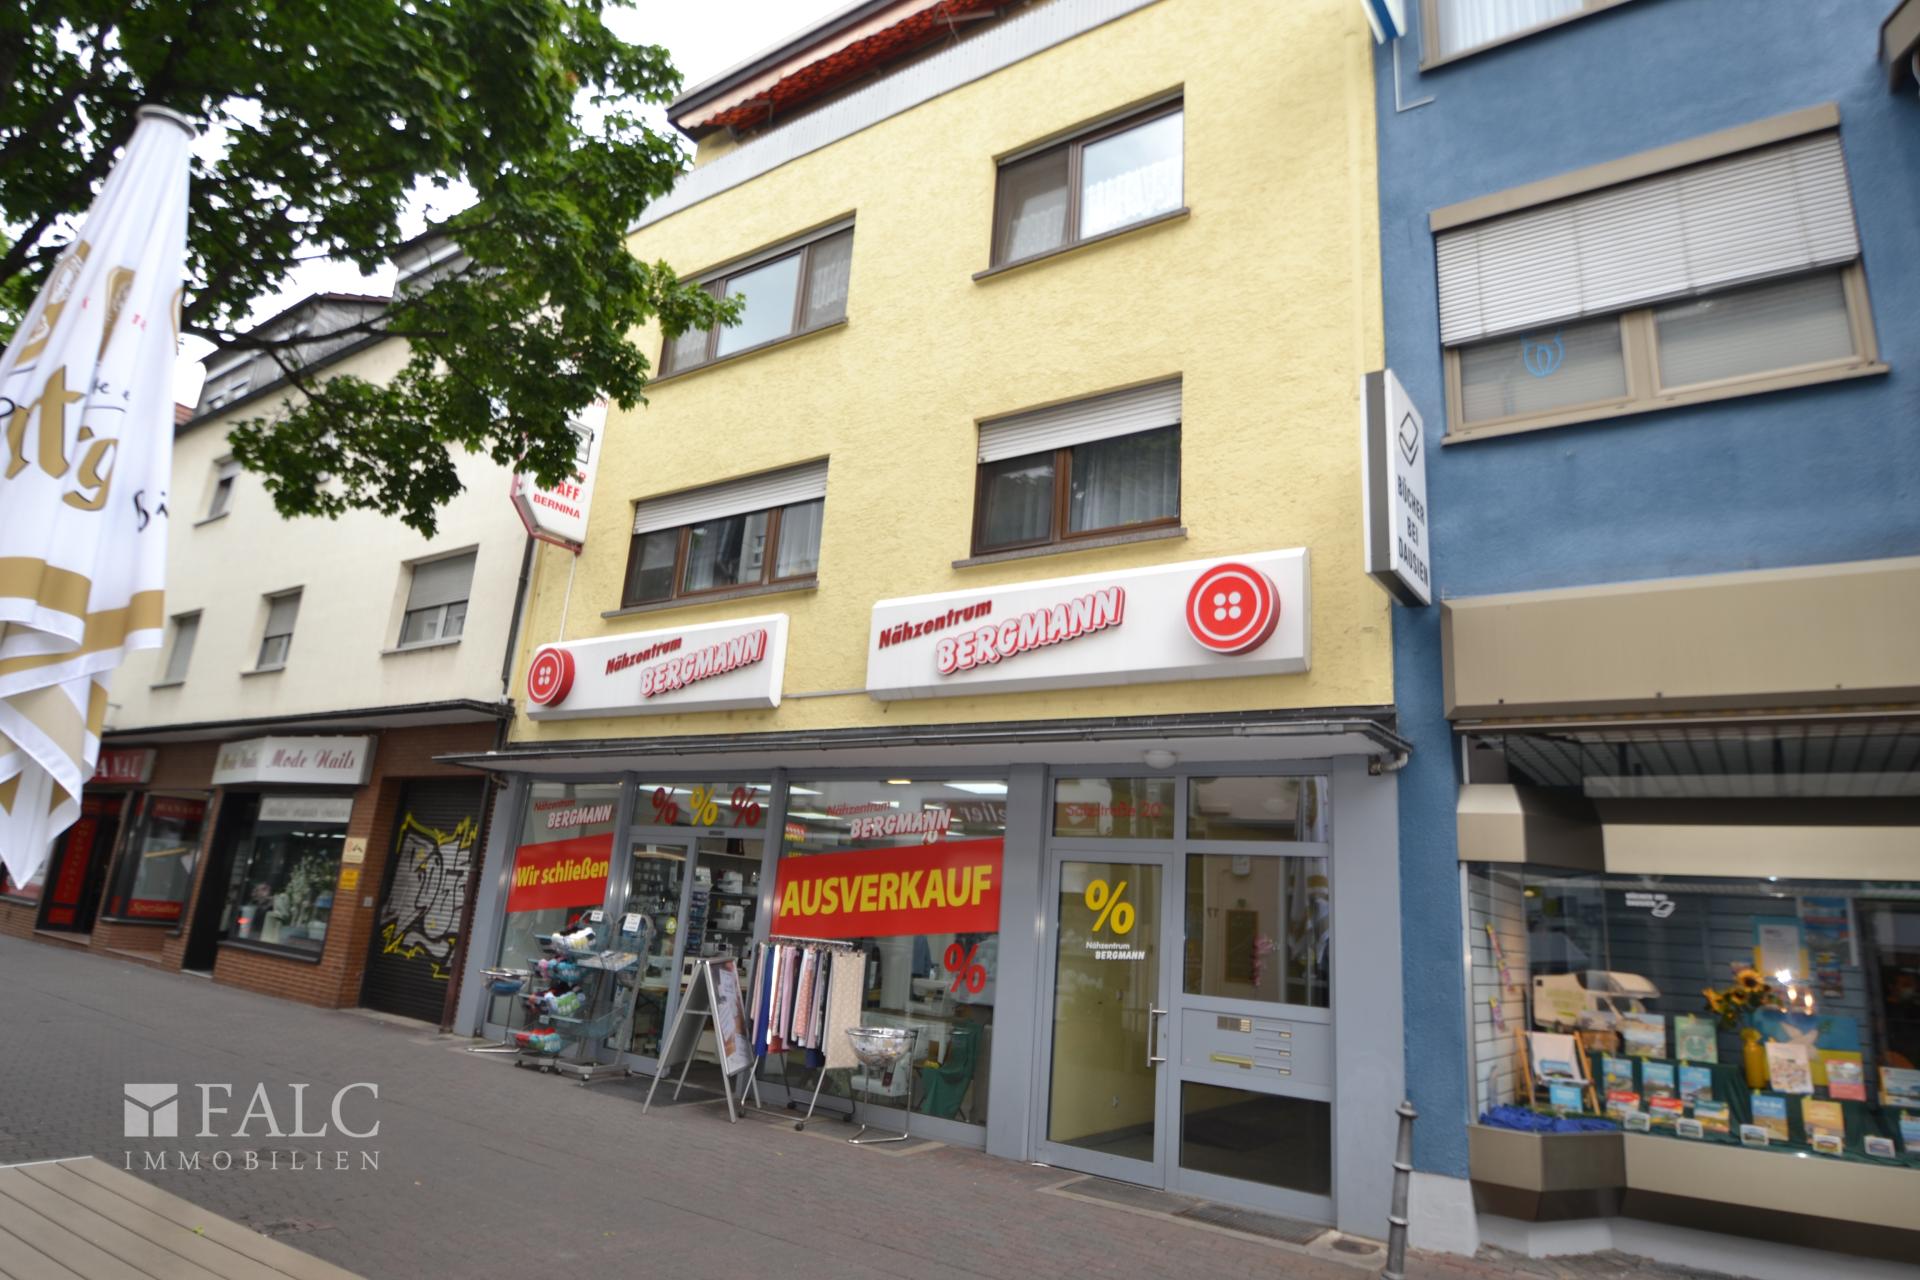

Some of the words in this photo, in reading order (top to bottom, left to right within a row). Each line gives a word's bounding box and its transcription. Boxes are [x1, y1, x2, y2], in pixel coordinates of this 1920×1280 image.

[533, 493, 581, 519] BERNINA
[1398, 474, 1425, 527] BÜCHER
[1406, 516, 1419, 547] BEI
[1398, 536, 1428, 587] DAUSIEN
[878, 599, 993, 650] Nähzentrum
[935, 586, 1126, 677] BERGMANN
[605, 637, 683, 676] Nähzentrum
[640, 628, 768, 699] BERGMANN
[266, 748, 308, 769] Mode
[314, 748, 355, 769] Nails
[547, 804, 614, 829] BERGMANN
[826, 801, 891, 817] Nähzentrum
[850, 808, 952, 840] BERGMANN
[516, 862, 539, 888] Wir
[541, 857, 610, 886] schließen
[779, 864, 993, 918] AUSVERKAUF
[1085, 940, 1131, 951] Nähzentrum
[1095, 950, 1146, 961] BERGMANN
